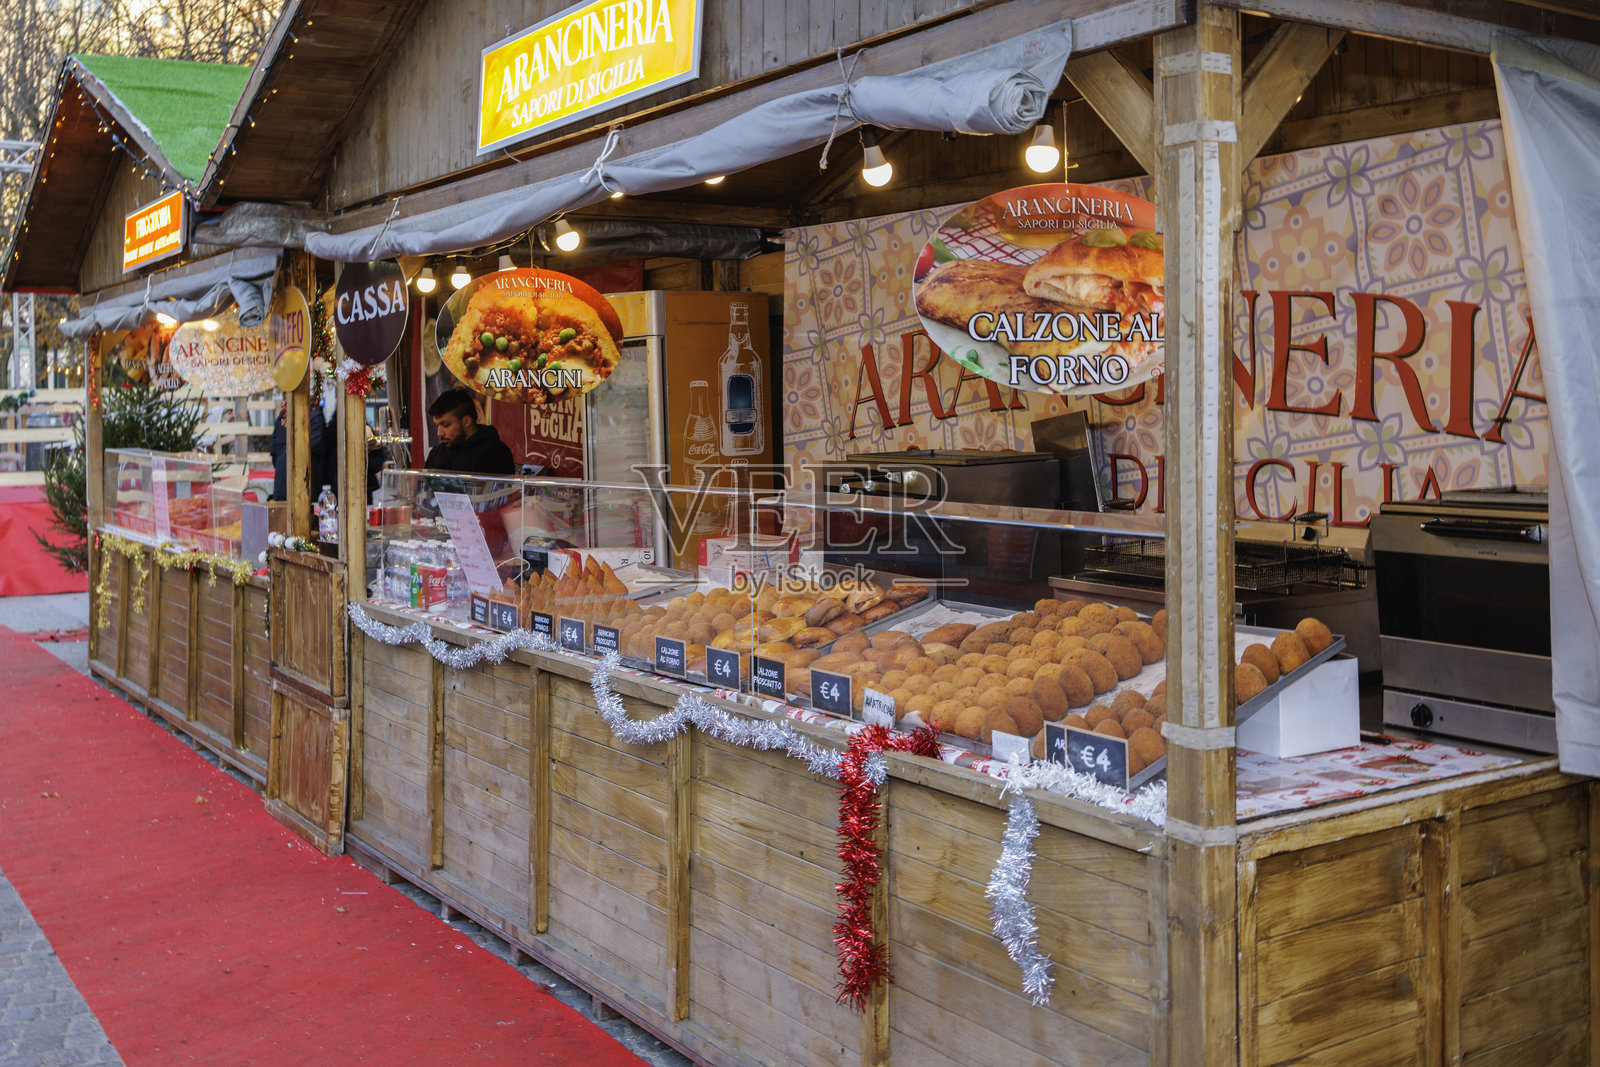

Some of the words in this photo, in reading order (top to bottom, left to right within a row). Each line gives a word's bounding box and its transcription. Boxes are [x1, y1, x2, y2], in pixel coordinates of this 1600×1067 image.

[496, 0, 674, 112] ARANCINERIA
[511, 86, 562, 128] SAPORI
[565, 78, 585, 107] DI
[587, 55, 645, 99] SICILIA
[1002, 196, 1135, 221] ARANCINERIA
[1017, 218, 1059, 229] SAPORI
[1062, 219, 1075, 229] DI
[1079, 219, 1119, 230] SICILIA
[492, 276, 574, 293] ARANCINERIA
[501, 290, 529, 298] SAPORI
[539, 291, 564, 299] SICILIA
[337, 280, 405, 325] CASSA
[274, 309, 304, 357] RAFFO
[968, 312, 1122, 342] CALZONE
[1126, 312, 1164, 342] AL
[191, 358, 229, 368] SAPORI
[1009, 355, 1130, 385] FORNO
[485, 369, 582, 389] ARANCINI
[501, 610, 513, 625] €4
[565, 627, 578, 643] €4
[660, 646, 679, 657] CALZONE
[714, 659, 731, 678] €4
[820, 681, 840, 702] €4
[1080, 745, 1112, 772] €4
